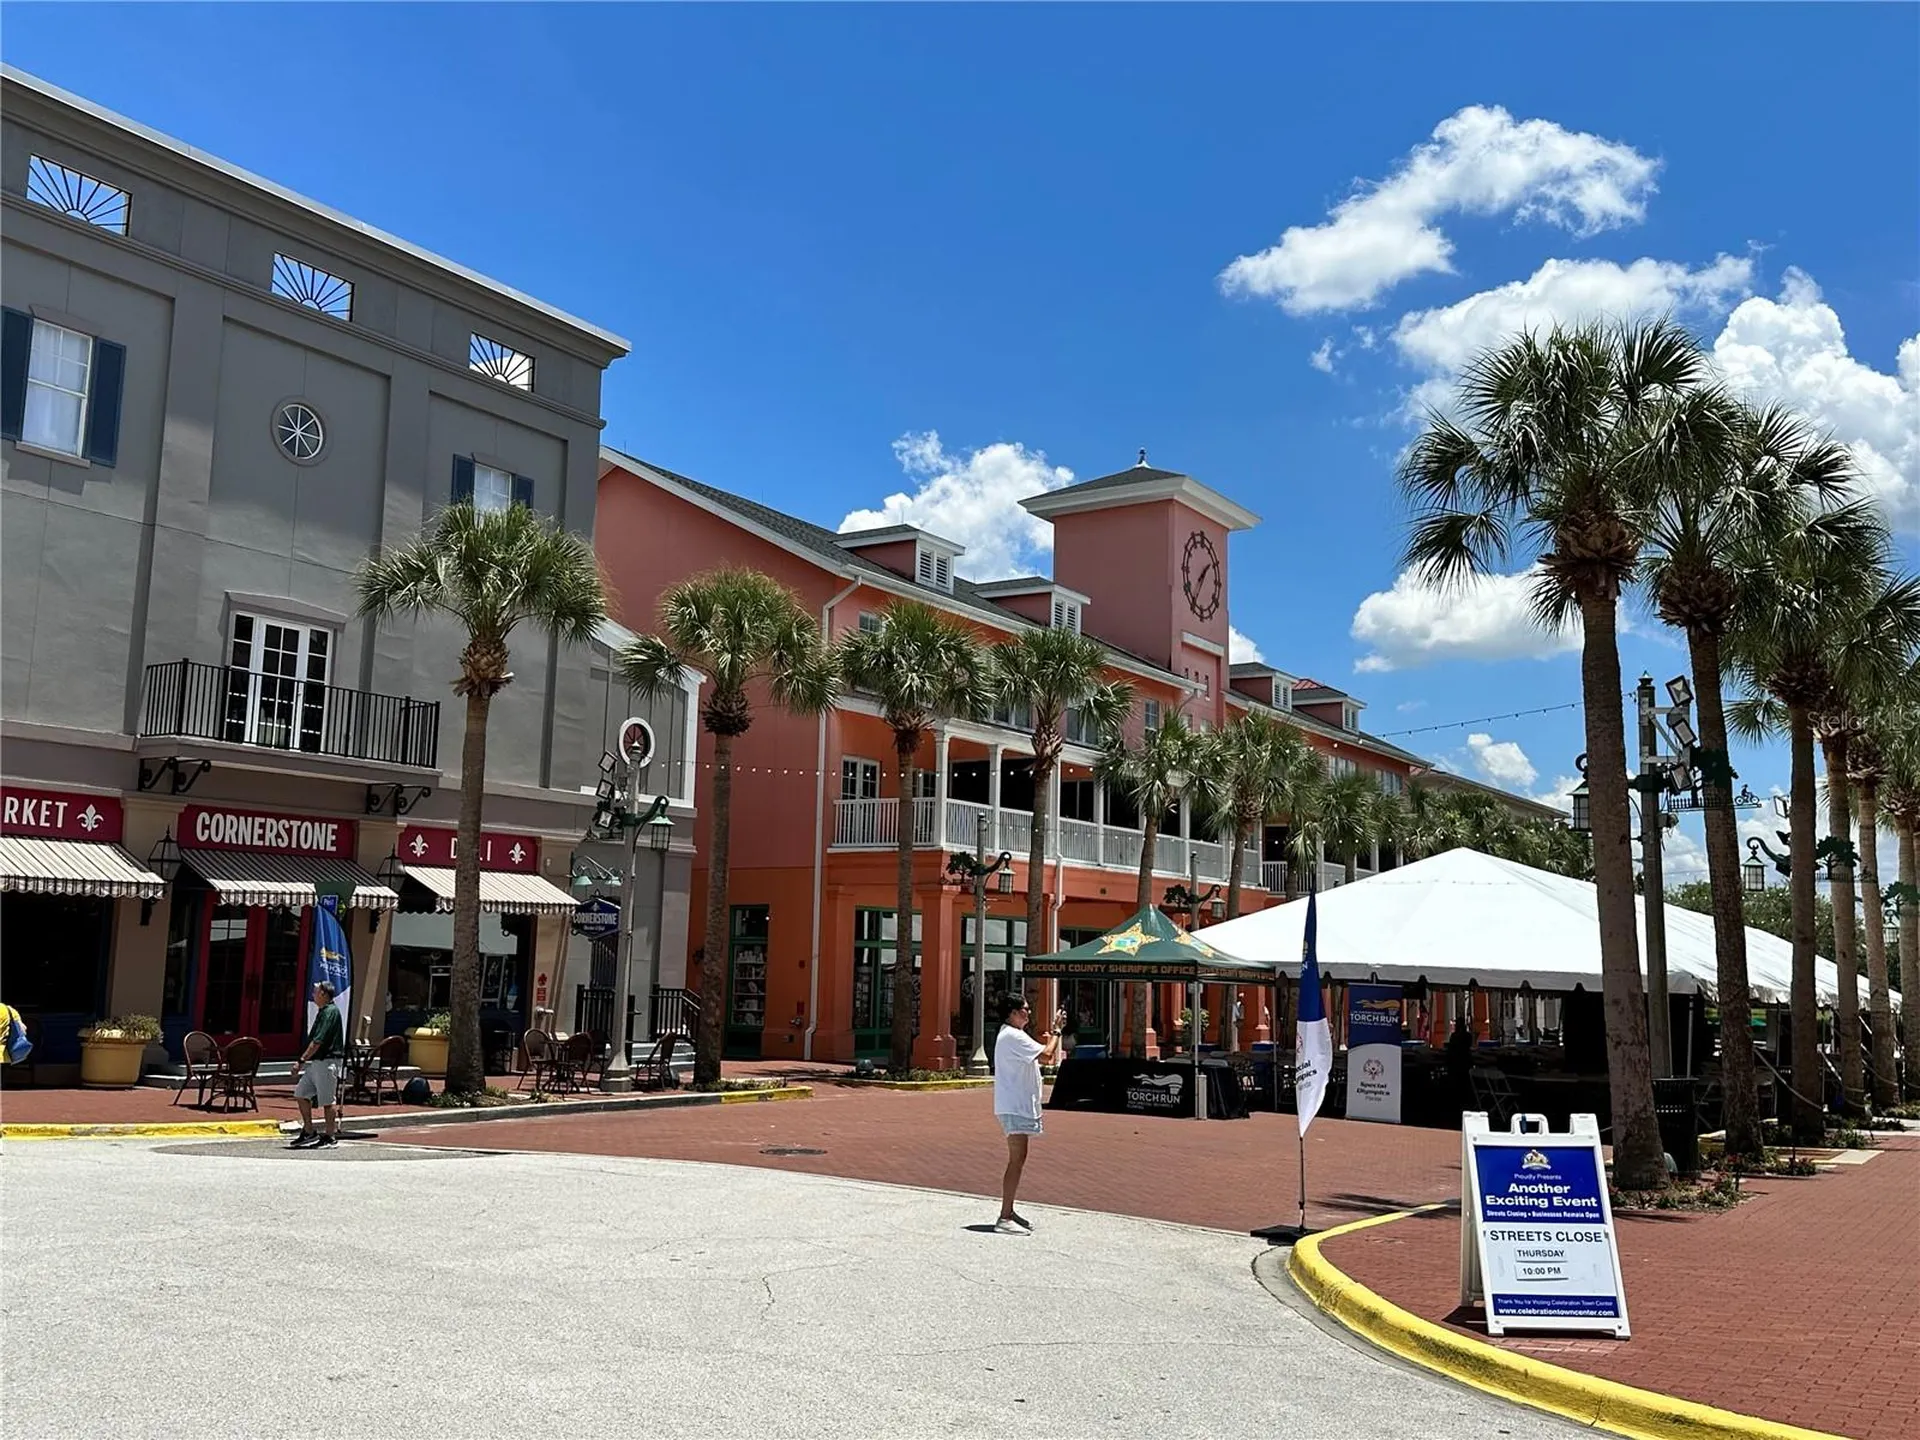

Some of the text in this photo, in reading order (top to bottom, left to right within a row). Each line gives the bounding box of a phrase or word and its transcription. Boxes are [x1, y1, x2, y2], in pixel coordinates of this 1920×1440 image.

[4, 796, 68, 829] RKET
[196, 811, 339, 852] CORNERSTONE
[450, 837, 493, 862] DI
[572, 912, 618, 925] CORNERSTONE
[1024, 963, 1066, 972] OSCEOLA
[1068, 964, 1106, 973] COUNTY
[1160, 965, 1195, 974] OFFICE
[1350, 1013, 1379, 1022] TORCH
[1380, 1015, 1399, 1024] RUN
[1126, 1091, 1159, 1103] TORCH
[1160, 1093, 1181, 1104] RUN
[1508, 1183, 1571, 1194] Another
[1485, 1195, 1598, 1208] Exciting Event
[1489, 1230, 1603, 1242] STREETS CLOSE
[1517, 1249, 1565, 1257] THURSDAY
[1522, 1267, 1546, 1275] 10:00
[1498, 1307, 1615, 1316] www.celebrationtowncenter.com
